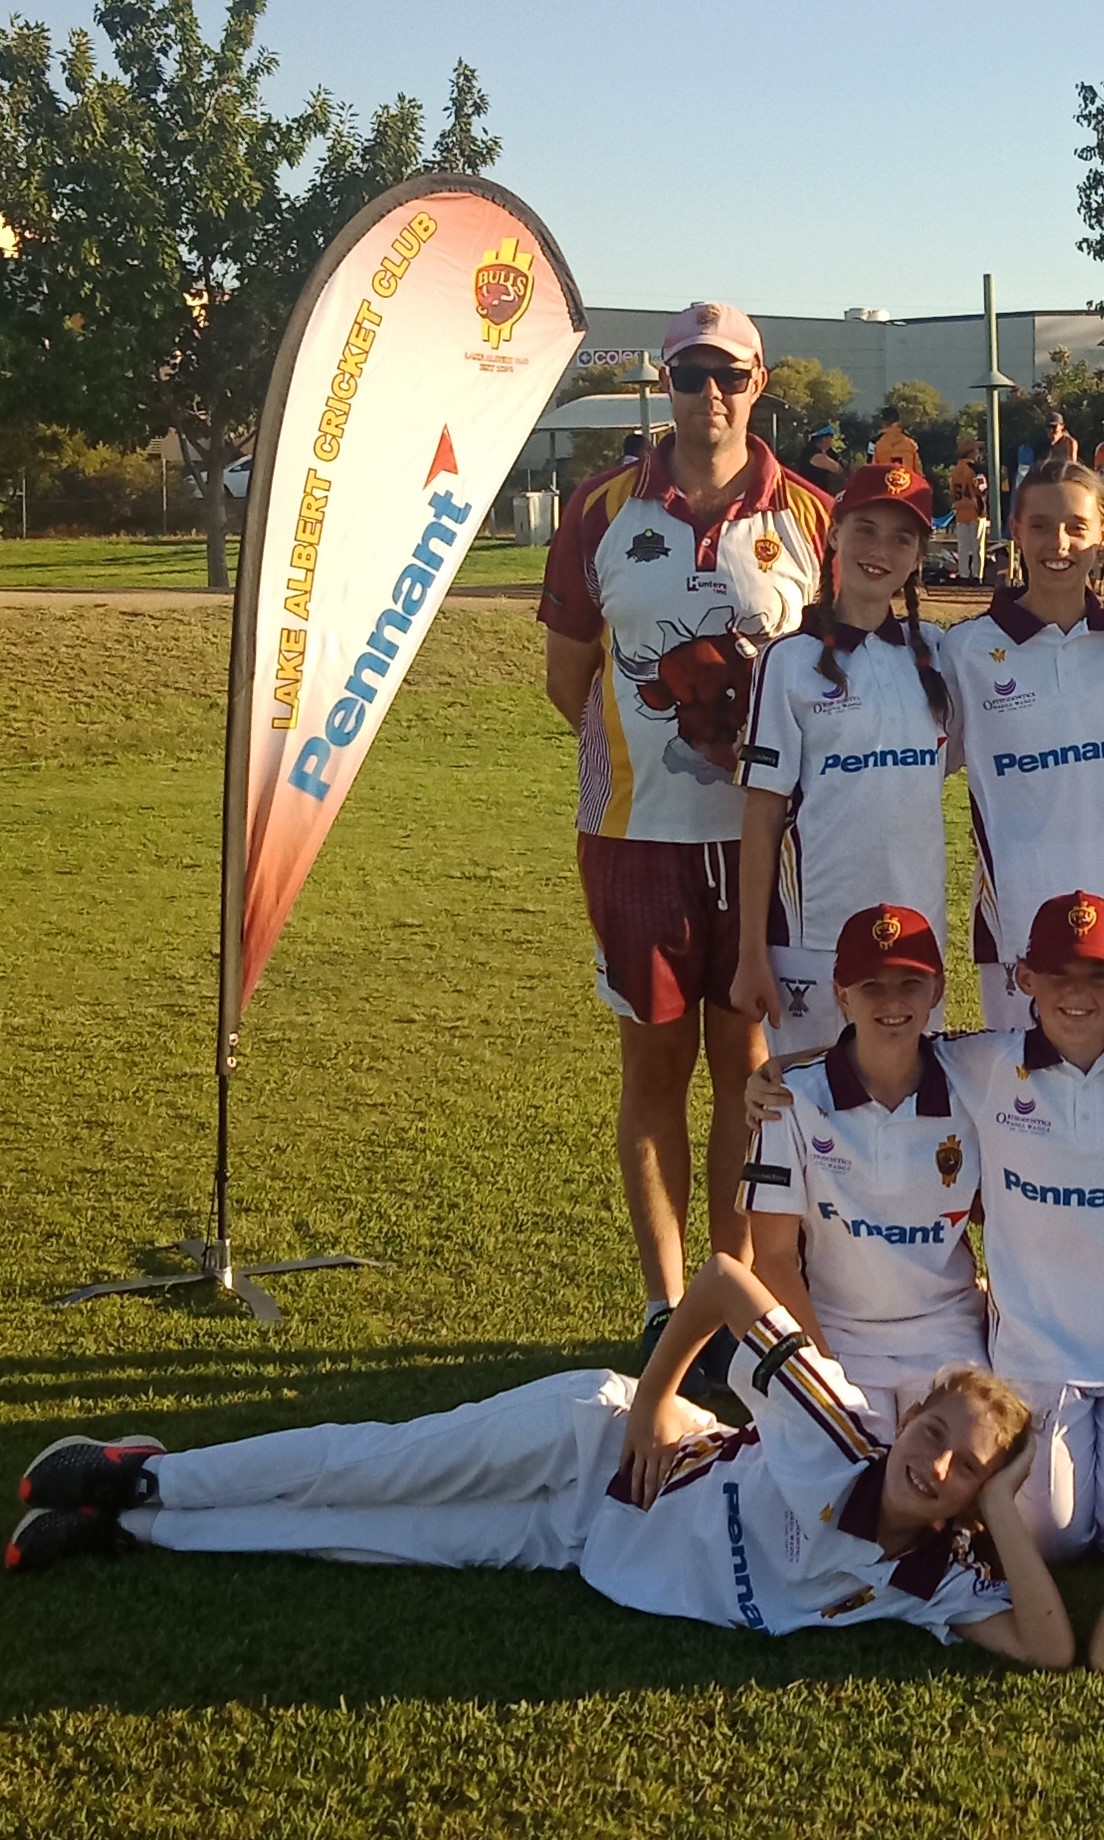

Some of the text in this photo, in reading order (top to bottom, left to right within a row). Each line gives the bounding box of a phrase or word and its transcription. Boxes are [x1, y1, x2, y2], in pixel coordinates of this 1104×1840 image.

[478, 270, 527, 297] BULLS
[272, 211, 438, 729] LAKE ALBERT CRICKET CLUB
[287, 489, 473, 802] Pennant
[820, 747, 939, 776] Pennan
[818, 1201, 945, 1246] Pnnant
[722, 1482, 771, 1636] Penna
